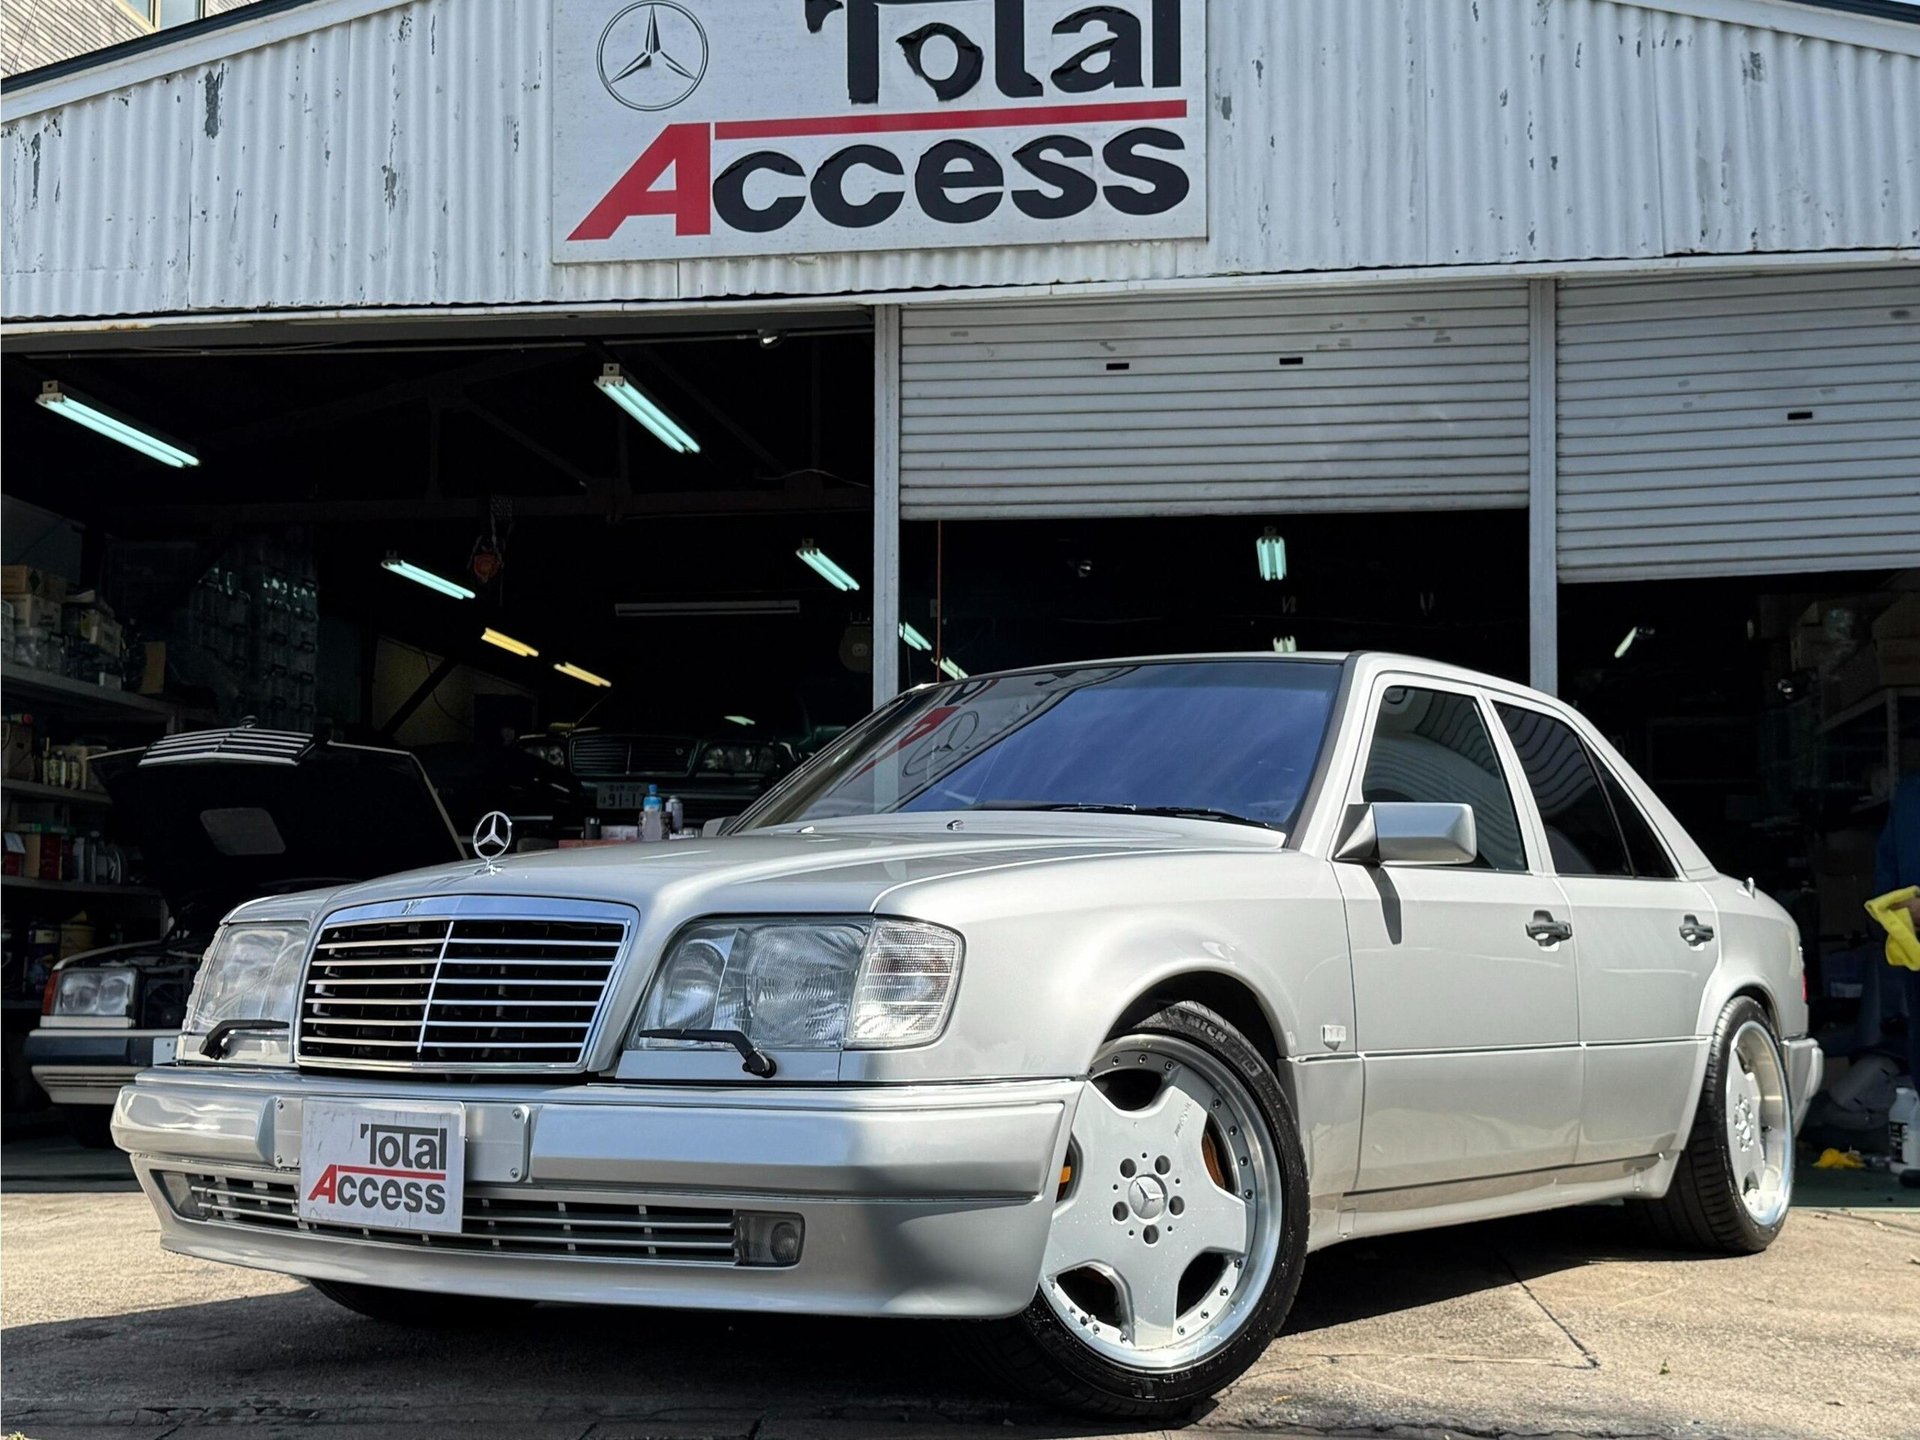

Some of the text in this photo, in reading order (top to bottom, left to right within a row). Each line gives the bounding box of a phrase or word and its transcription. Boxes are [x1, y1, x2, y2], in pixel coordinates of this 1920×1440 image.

[805, 0, 1181, 104] Total
[566, 122, 1190, 240] Access
[360, 1123, 447, 1170] Total
[307, 1164, 446, 1215] Access
